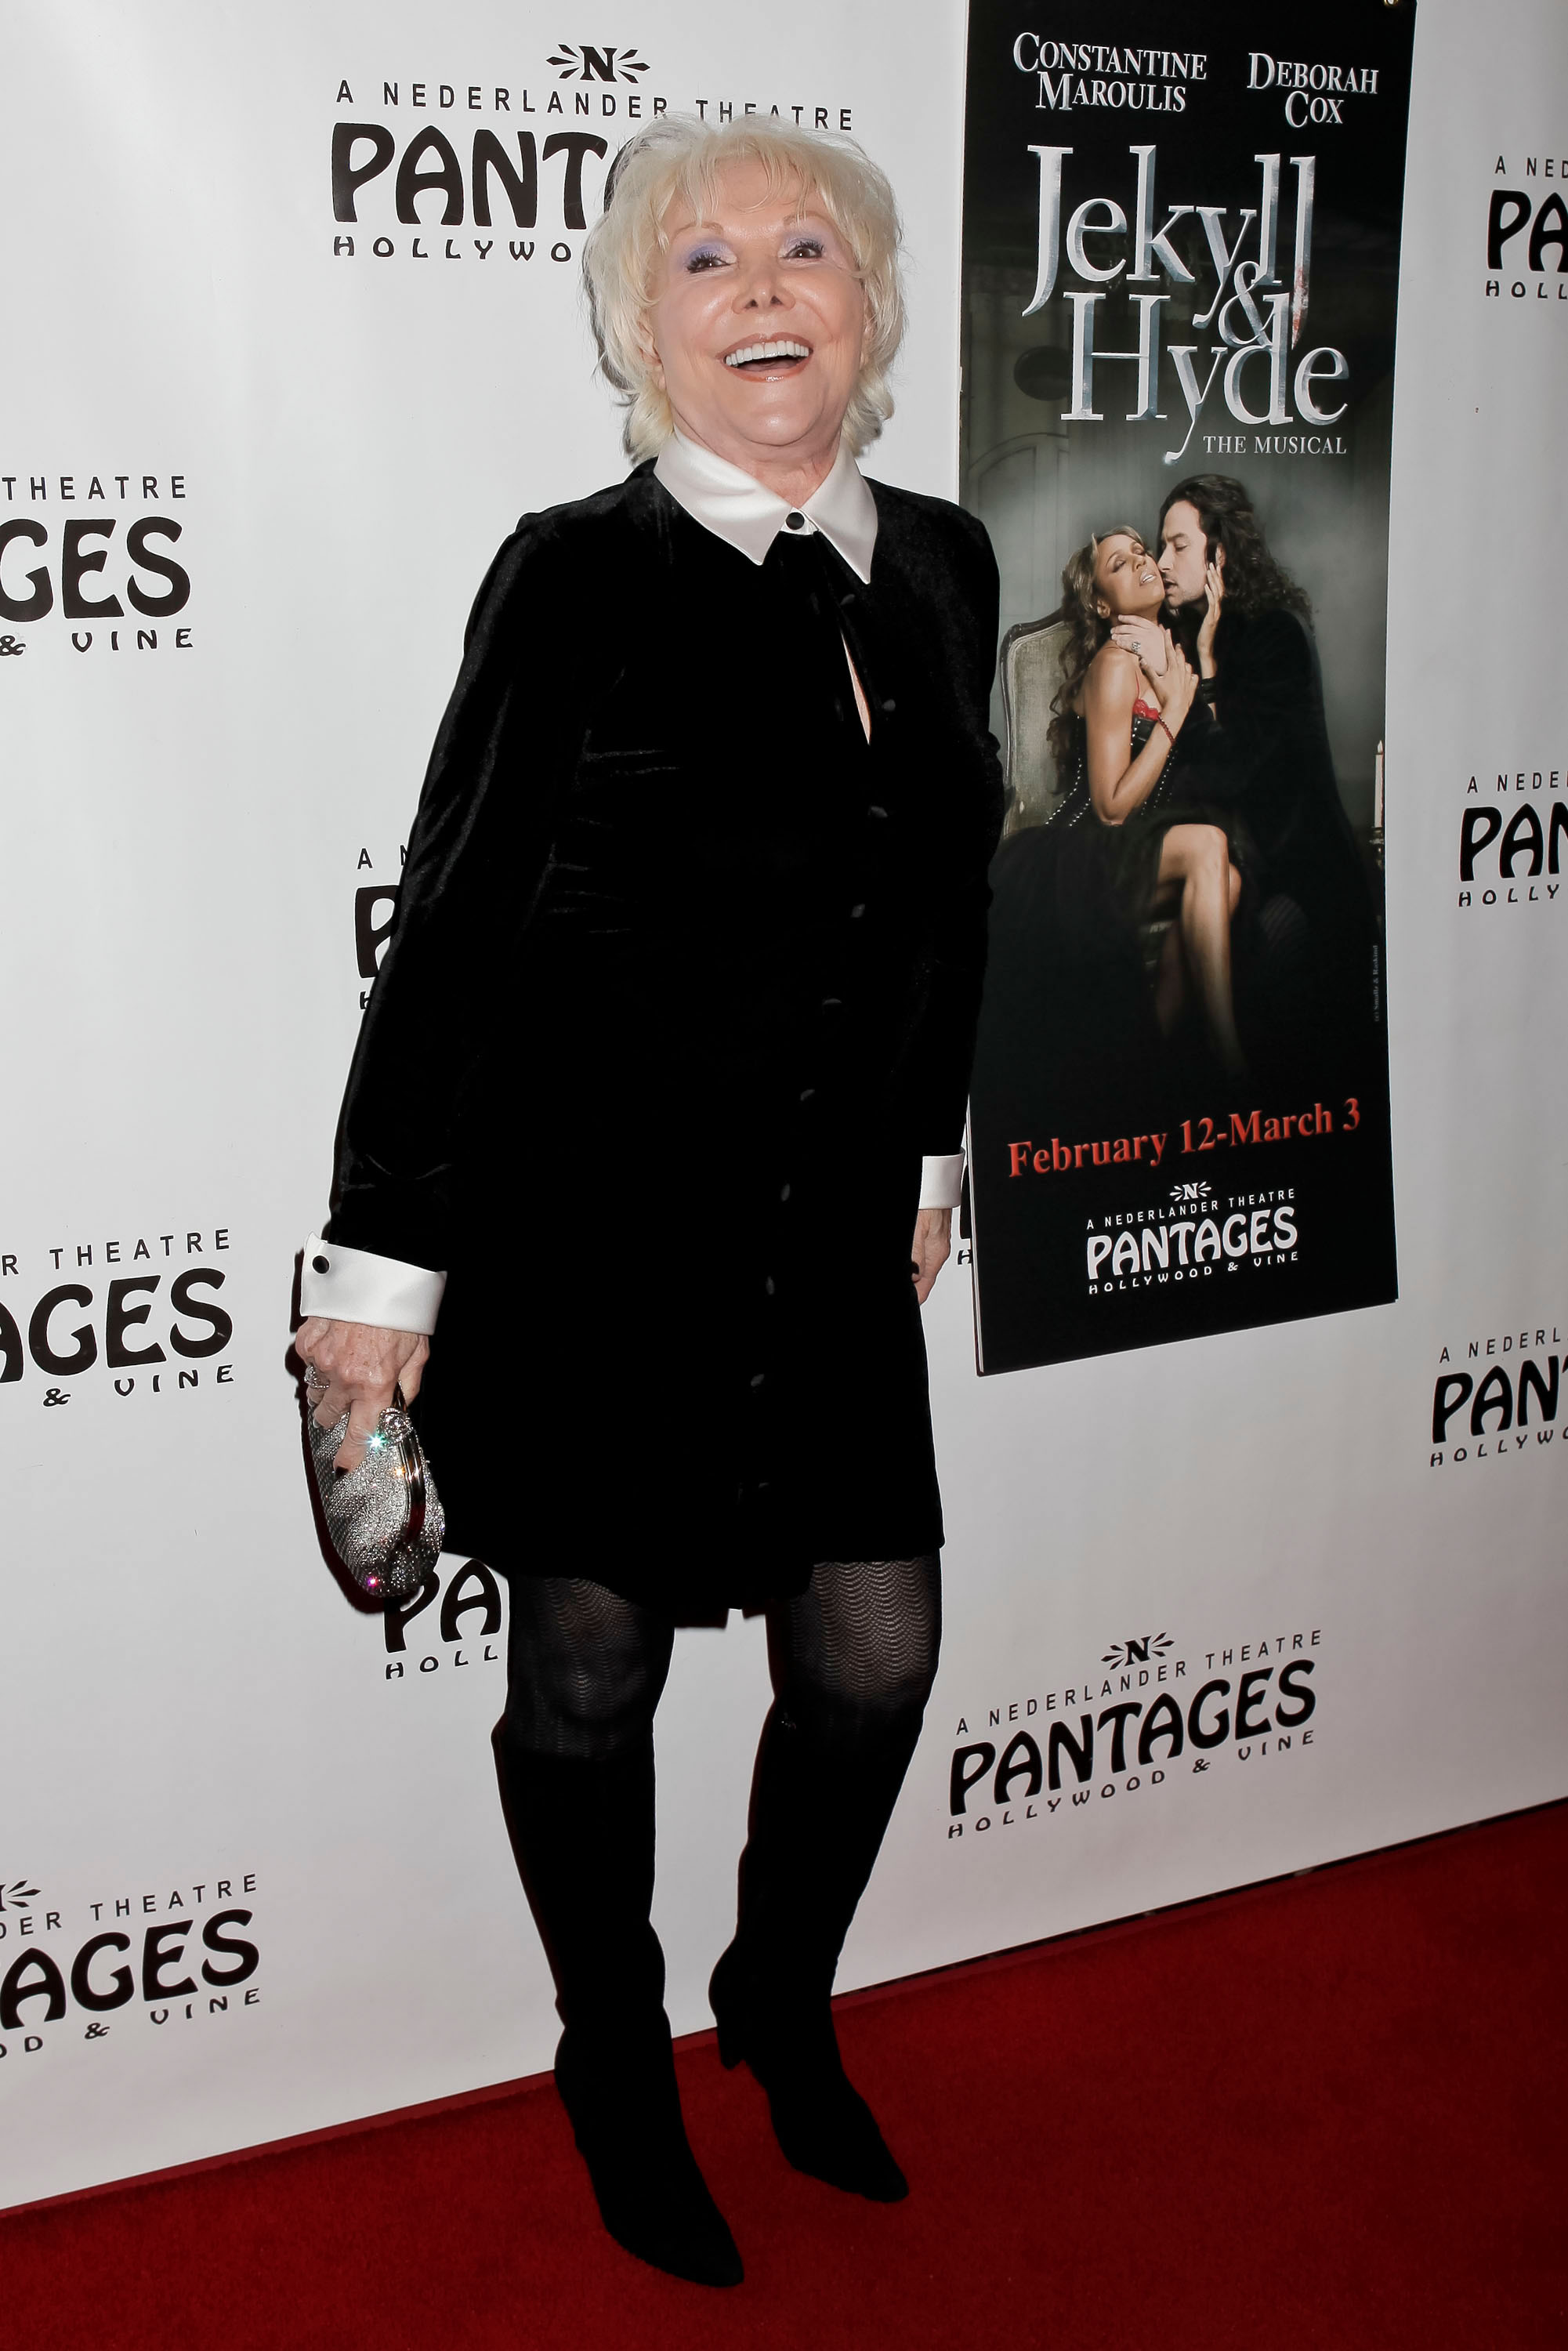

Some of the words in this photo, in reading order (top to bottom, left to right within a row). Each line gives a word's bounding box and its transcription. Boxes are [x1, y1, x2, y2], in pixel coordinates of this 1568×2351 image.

[1013, 32, 1208, 80] CONSTANTINE
[1246, 52, 1379, 95] DEBORAH
[336, 80, 353, 103] A
[383, 82, 668, 118] NEDERLANDER
[1035, 71, 1186, 113] MAROULIS
[1284, 91, 1345, 129] COX
[331, 122, 636, 230] PANT
[1494, 155, 1506, 175] A
[1022, 144, 1316, 350] Jekyll
[1218, 260, 1274, 346] &
[1060, 291, 1348, 465] Hyde
[1203, 436, 1247, 454] THE
[1253, 436, 1347, 455] MUSICAL
[2, 476, 186, 501] THEATRE
[71, 628, 194, 653] VINE
[1467, 776, 1478, 794] A
[1497, 770, 1568, 792] NEDE
[357, 848, 373, 870] A
[1008, 1132, 1168, 1178] February
[1179, 1103, 1332, 1154] 12-March
[1342, 1097, 1360, 1131] 3
[1086, 1219, 1095, 1230] A
[1105, 1200, 1219, 1227] NEDERLANDER
[1228, 1188, 1295, 1208] THEATRE
[49, 1228, 230, 1270] THEATRE
[1086, 1206, 1298, 1280] PANTAGES
[1088, 1266, 1212, 1295] HOLLYWOOD
[1227, 1262, 1239, 1272] &
[1253, 1251, 1298, 1267] VINE
[1439, 1346, 1450, 1364] A
[1468, 1327, 1568, 1358] NEDERL
[42, 1388, 71, 1407] &
[114, 1364, 234, 1396] VINE
[1432, 1354, 1568, 1444] PAN
[956, 1717, 969, 1736] A
[989, 1661, 1187, 1727] NEDERLANDER
[1205, 1629, 1321, 1670] THEATRE
[950, 1659, 1316, 1817] PANTAGES
[948, 1770, 1166, 1839] HOLLYWOOD
[1192, 1758, 1211, 1773] &
[1237, 1730, 1314, 1761] VINE
[89, 1874, 257, 1922] THEATRE
[84, 2022, 110, 2040] &
[150, 1987, 261, 2025] VINE
